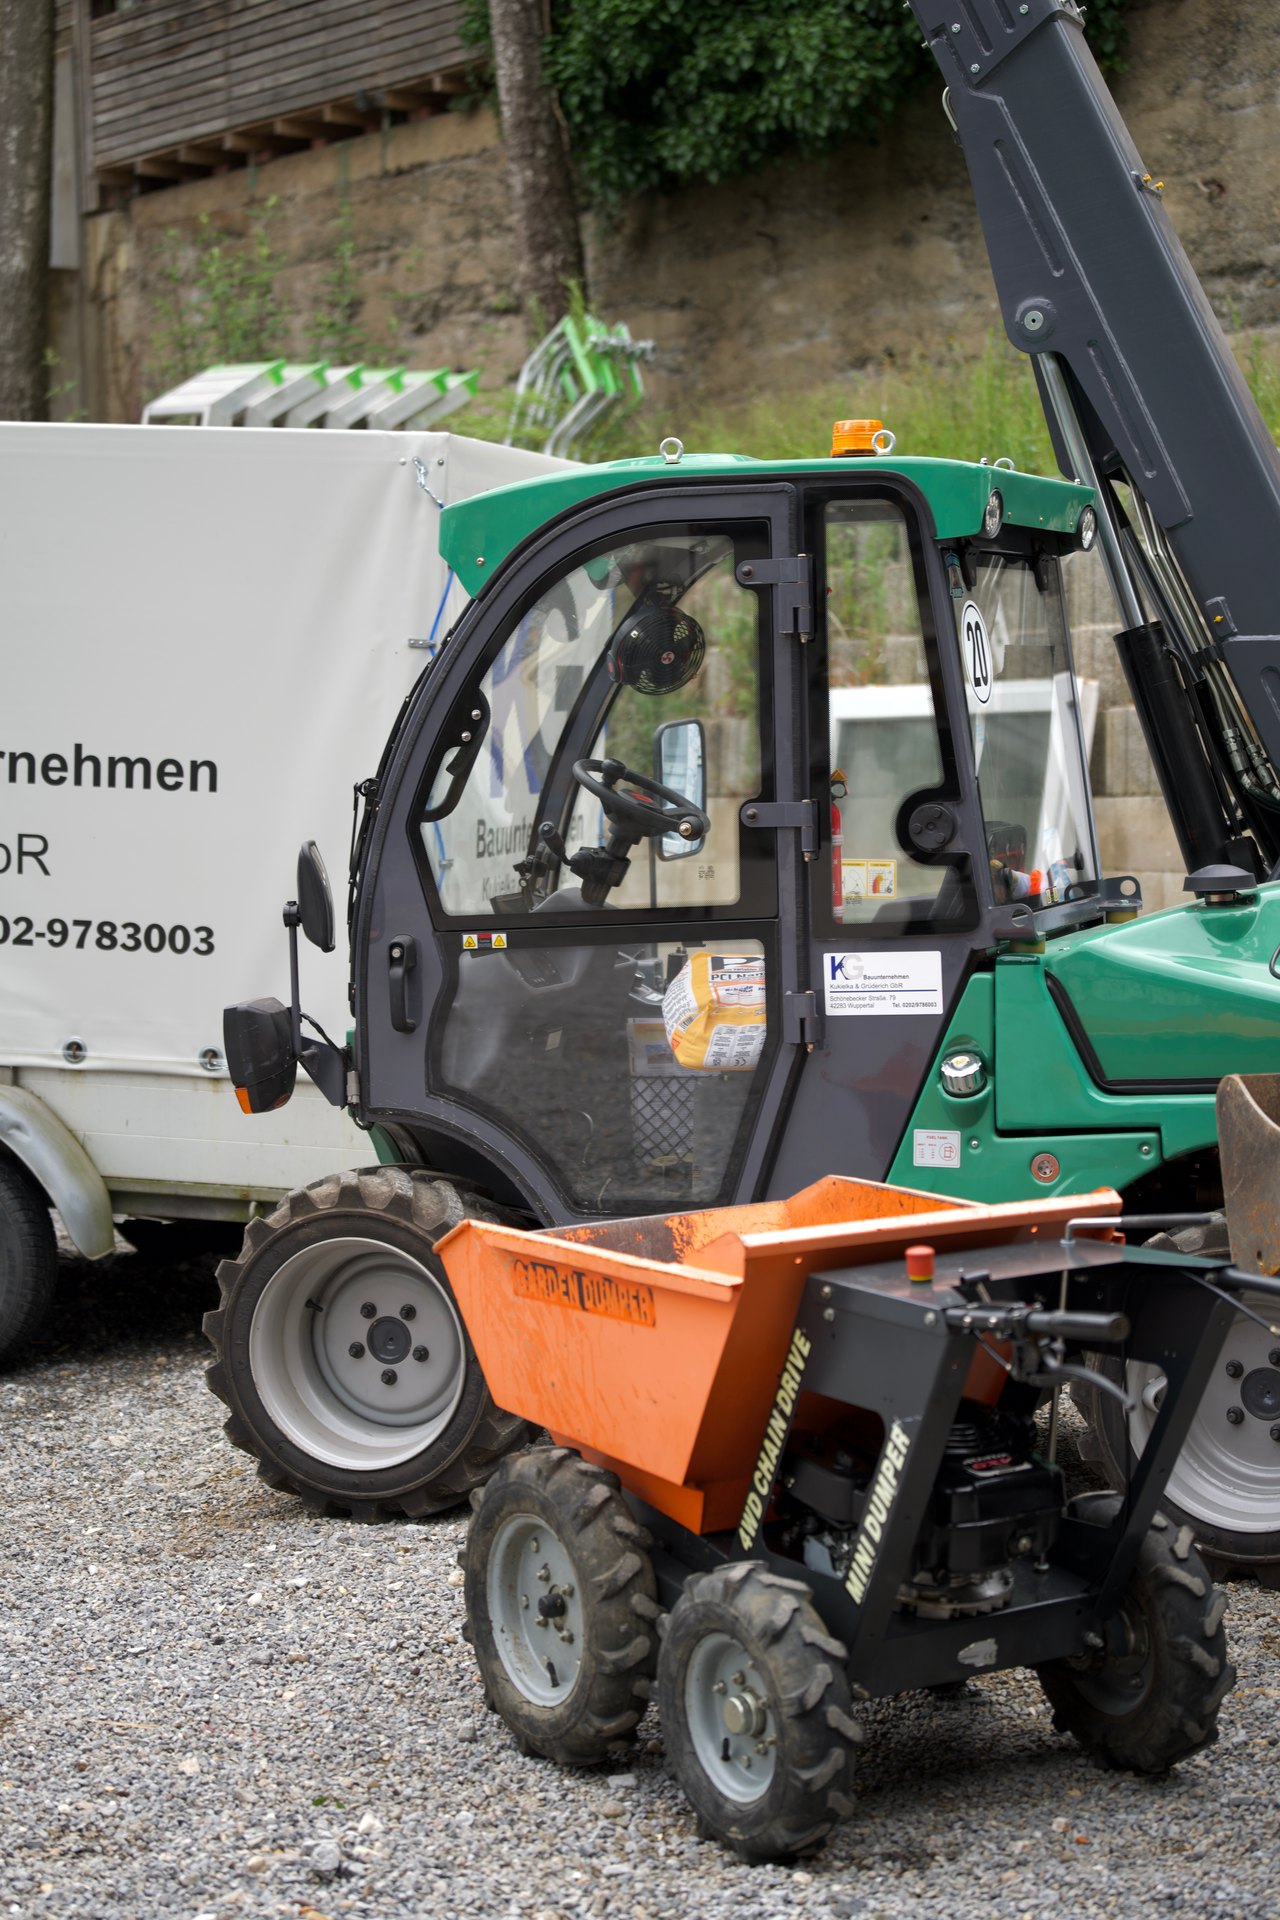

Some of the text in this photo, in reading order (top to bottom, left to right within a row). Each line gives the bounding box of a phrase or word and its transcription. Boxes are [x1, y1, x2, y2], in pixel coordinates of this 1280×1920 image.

[966, 620, 989, 688] 20
[0, 743, 218, 793] nehmen
[739, 1328, 812, 1551] 4WD CHAIN DRIVE
[845, 1418, 911, 1605] MINI DUMPER
